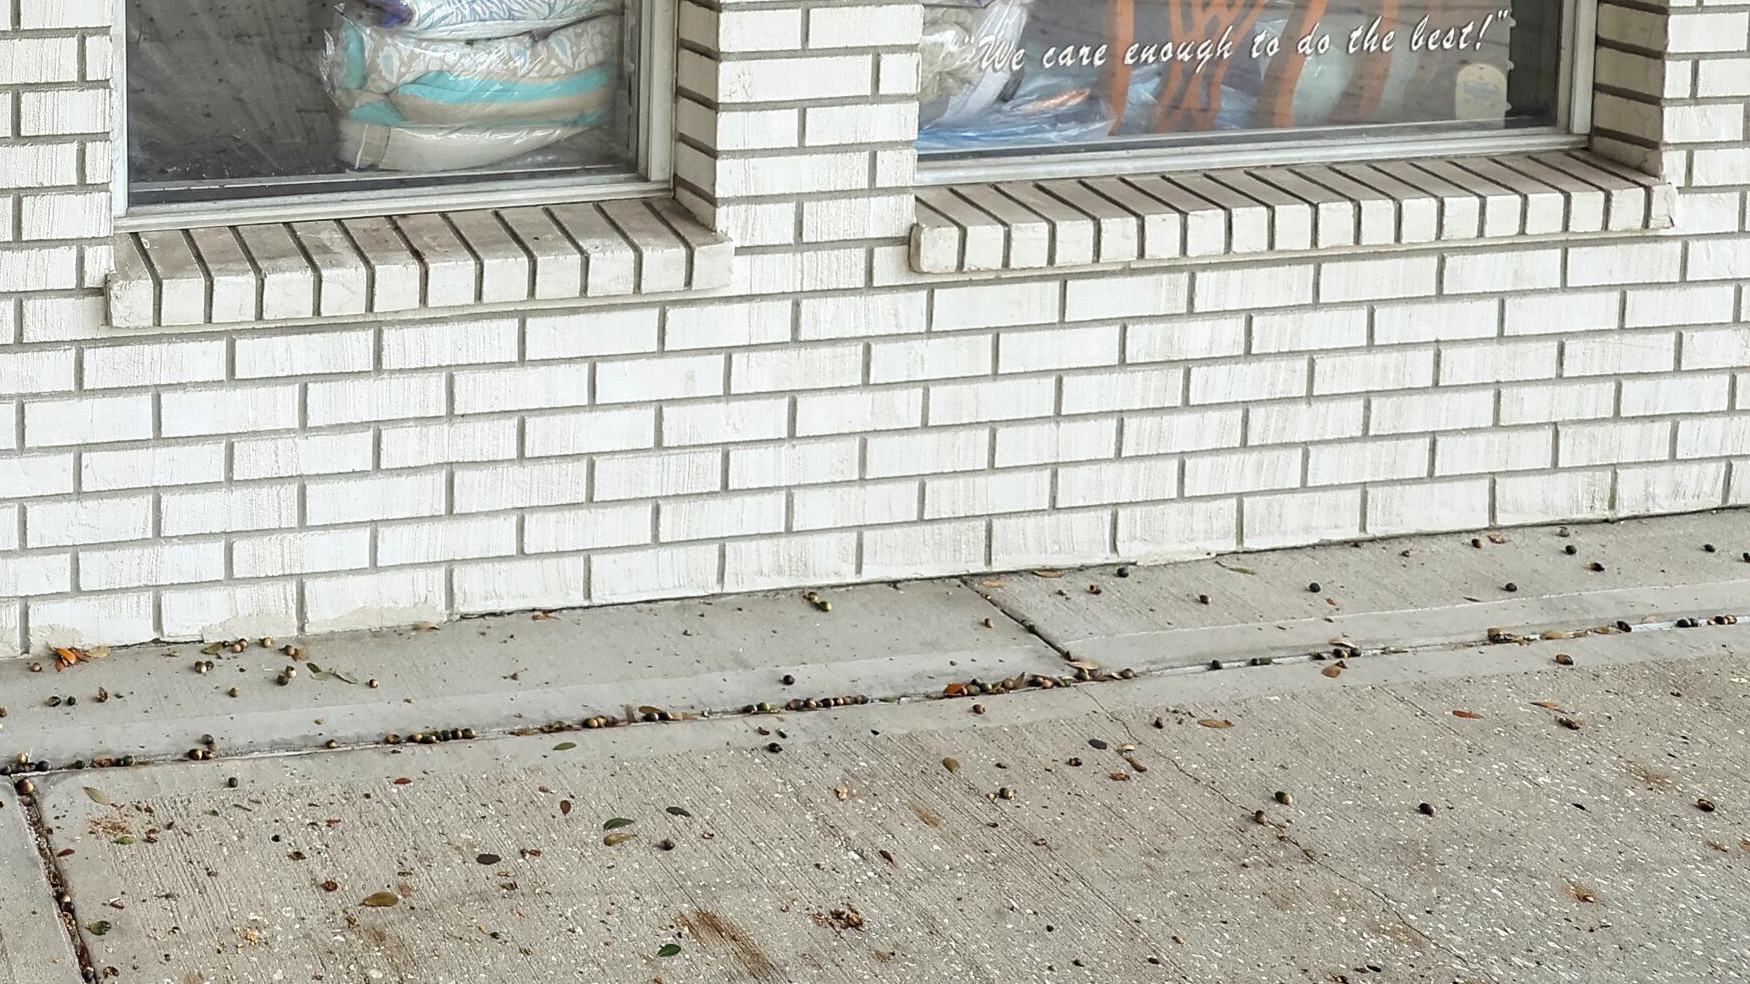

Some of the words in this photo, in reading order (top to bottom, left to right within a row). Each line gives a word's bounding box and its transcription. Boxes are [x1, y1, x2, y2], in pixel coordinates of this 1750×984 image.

[1042, 42, 1108, 67] care
[1124, 25, 1234, 74] enough
[1251, 29, 1281, 59] to
[1297, 22, 1331, 56] do
[1347, 15, 1395, 54] the
[1411, 9, 1509, 52] best!"
